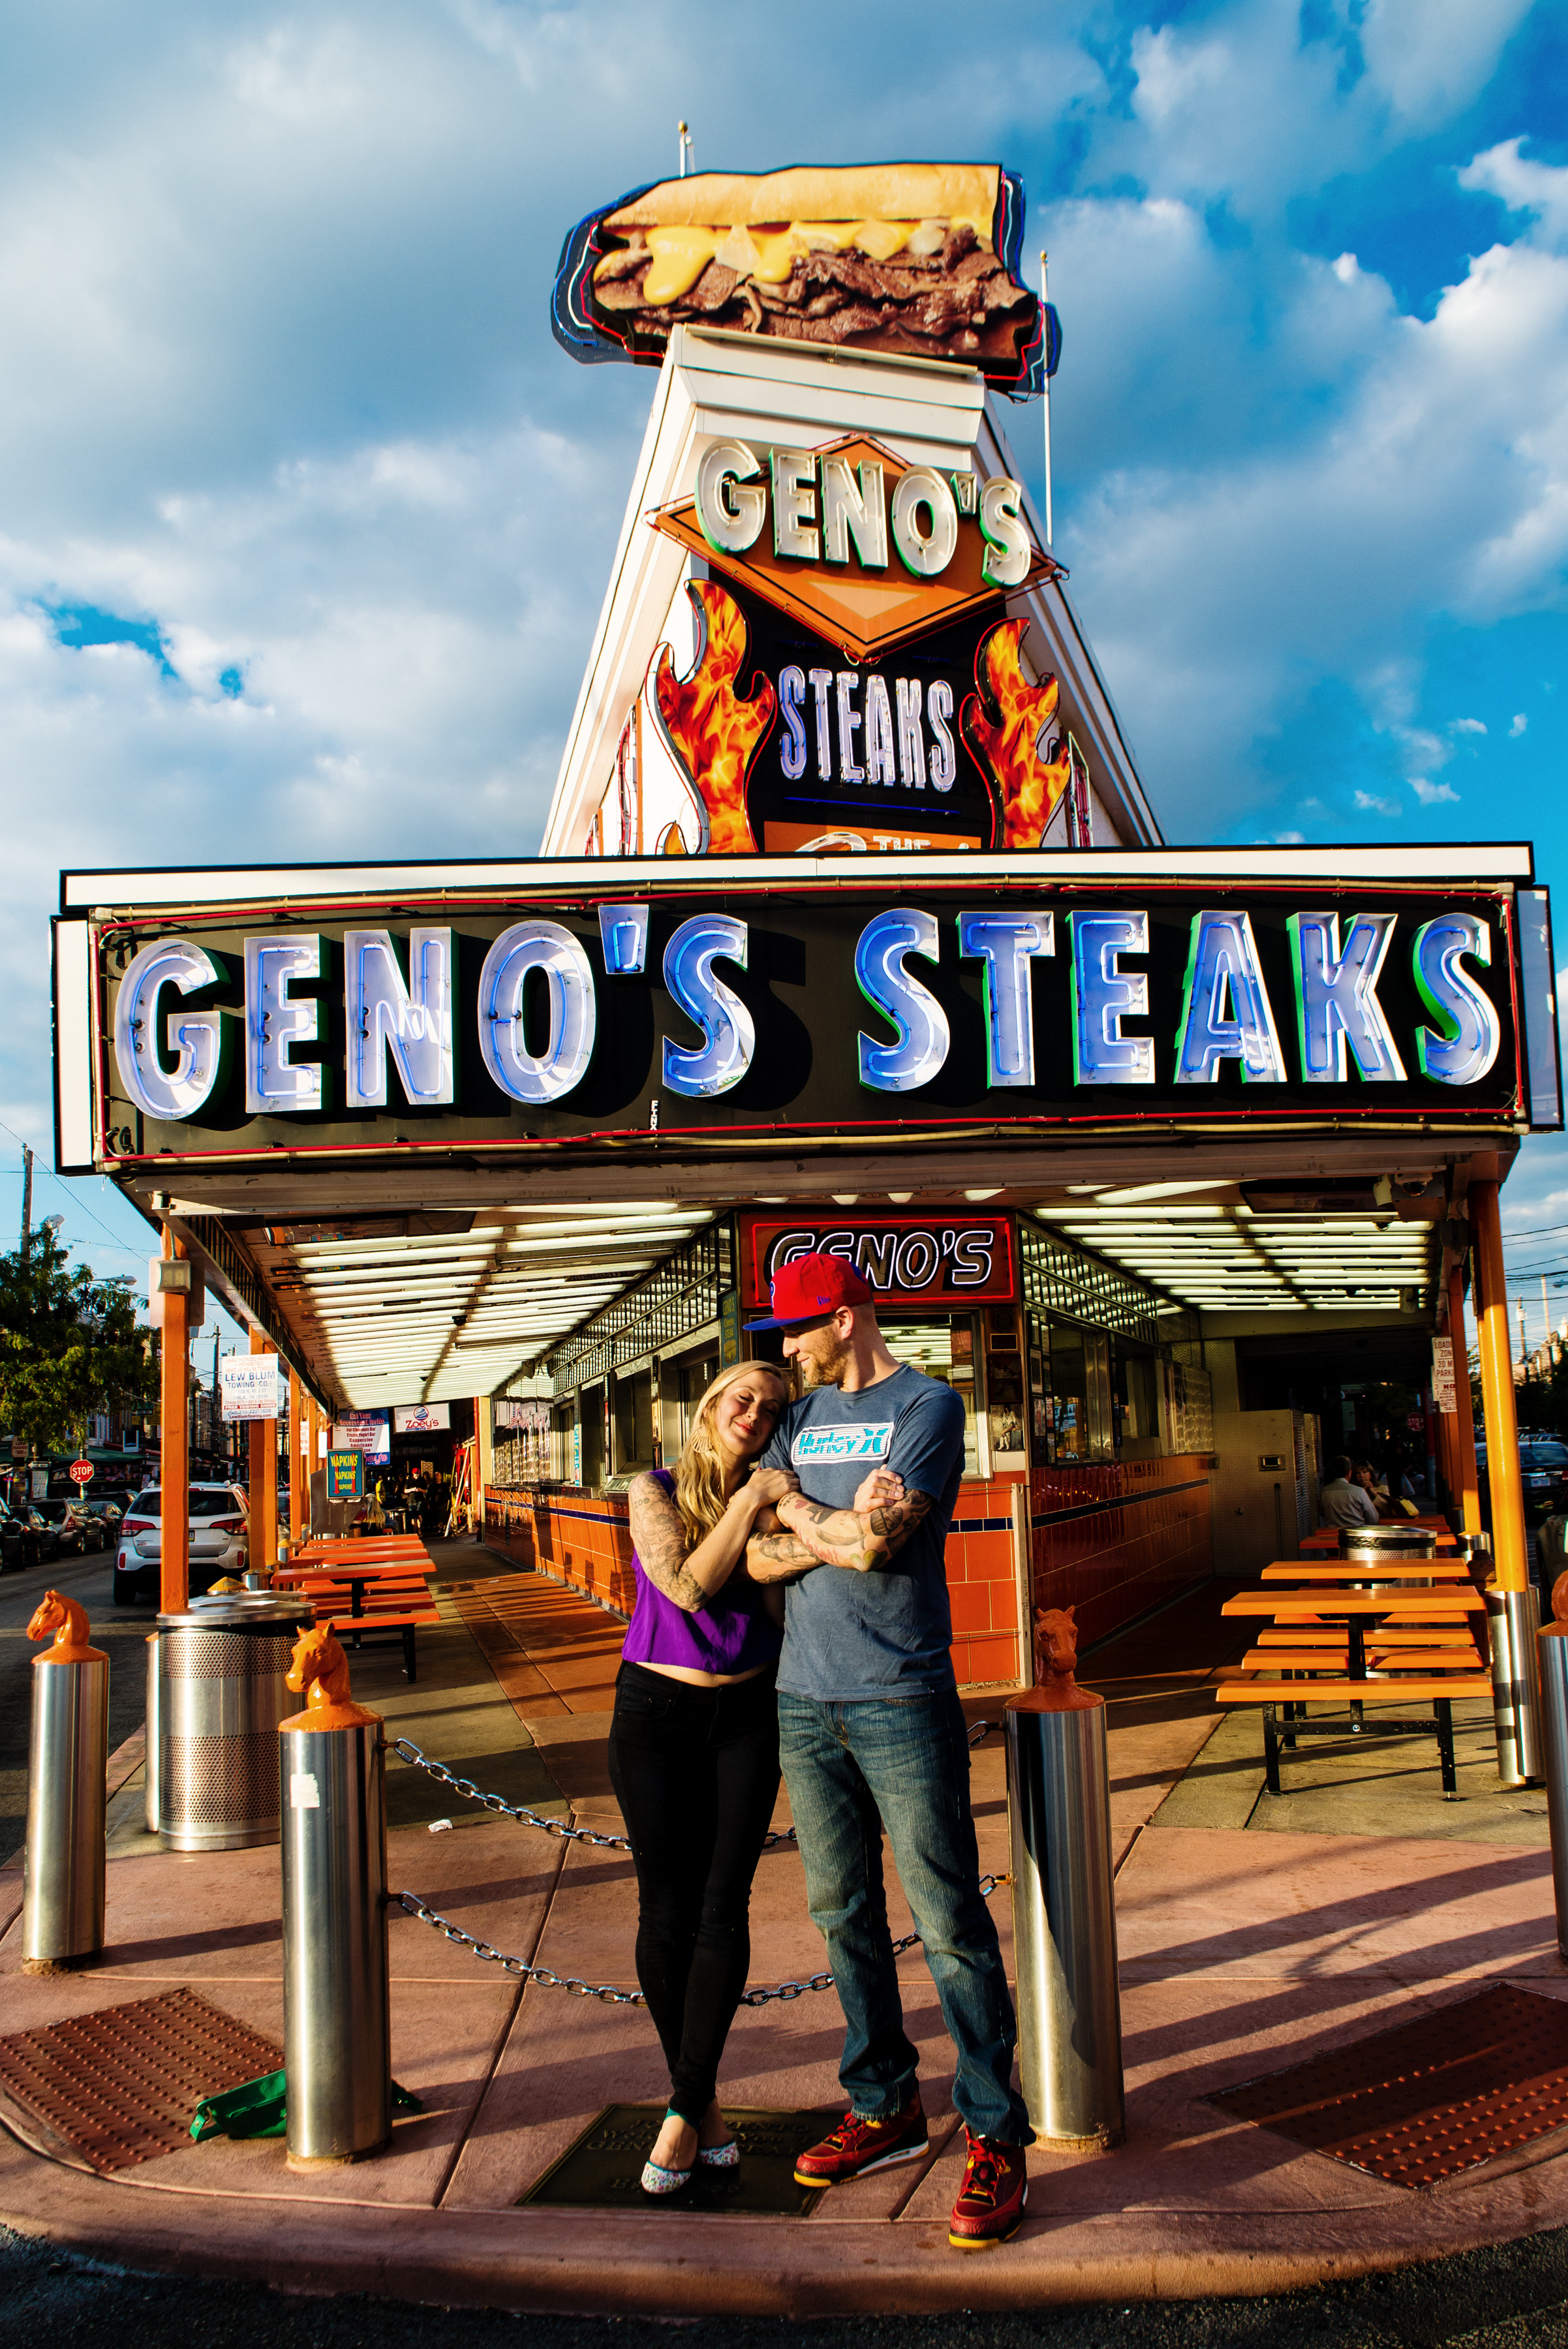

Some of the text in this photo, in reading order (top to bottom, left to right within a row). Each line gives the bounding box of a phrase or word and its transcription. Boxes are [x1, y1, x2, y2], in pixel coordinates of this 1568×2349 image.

[695, 438, 1032, 590] GENO'S
[778, 665, 957, 793] STEAKS
[115, 904, 1501, 1121] GENO'S STEAKS
[724, 1318, 735, 1328] Cheese
[225, 1371, 275, 1381] LEW BLUM
[405, 1418, 439, 1430] Zoey's
[798, 1431, 861, 1456] Hurley
[330, 1454, 358, 1467] NAPKINS
[72, 1466, 93, 1477] STOP
[334, 1471, 356, 1481] NAPKINS
